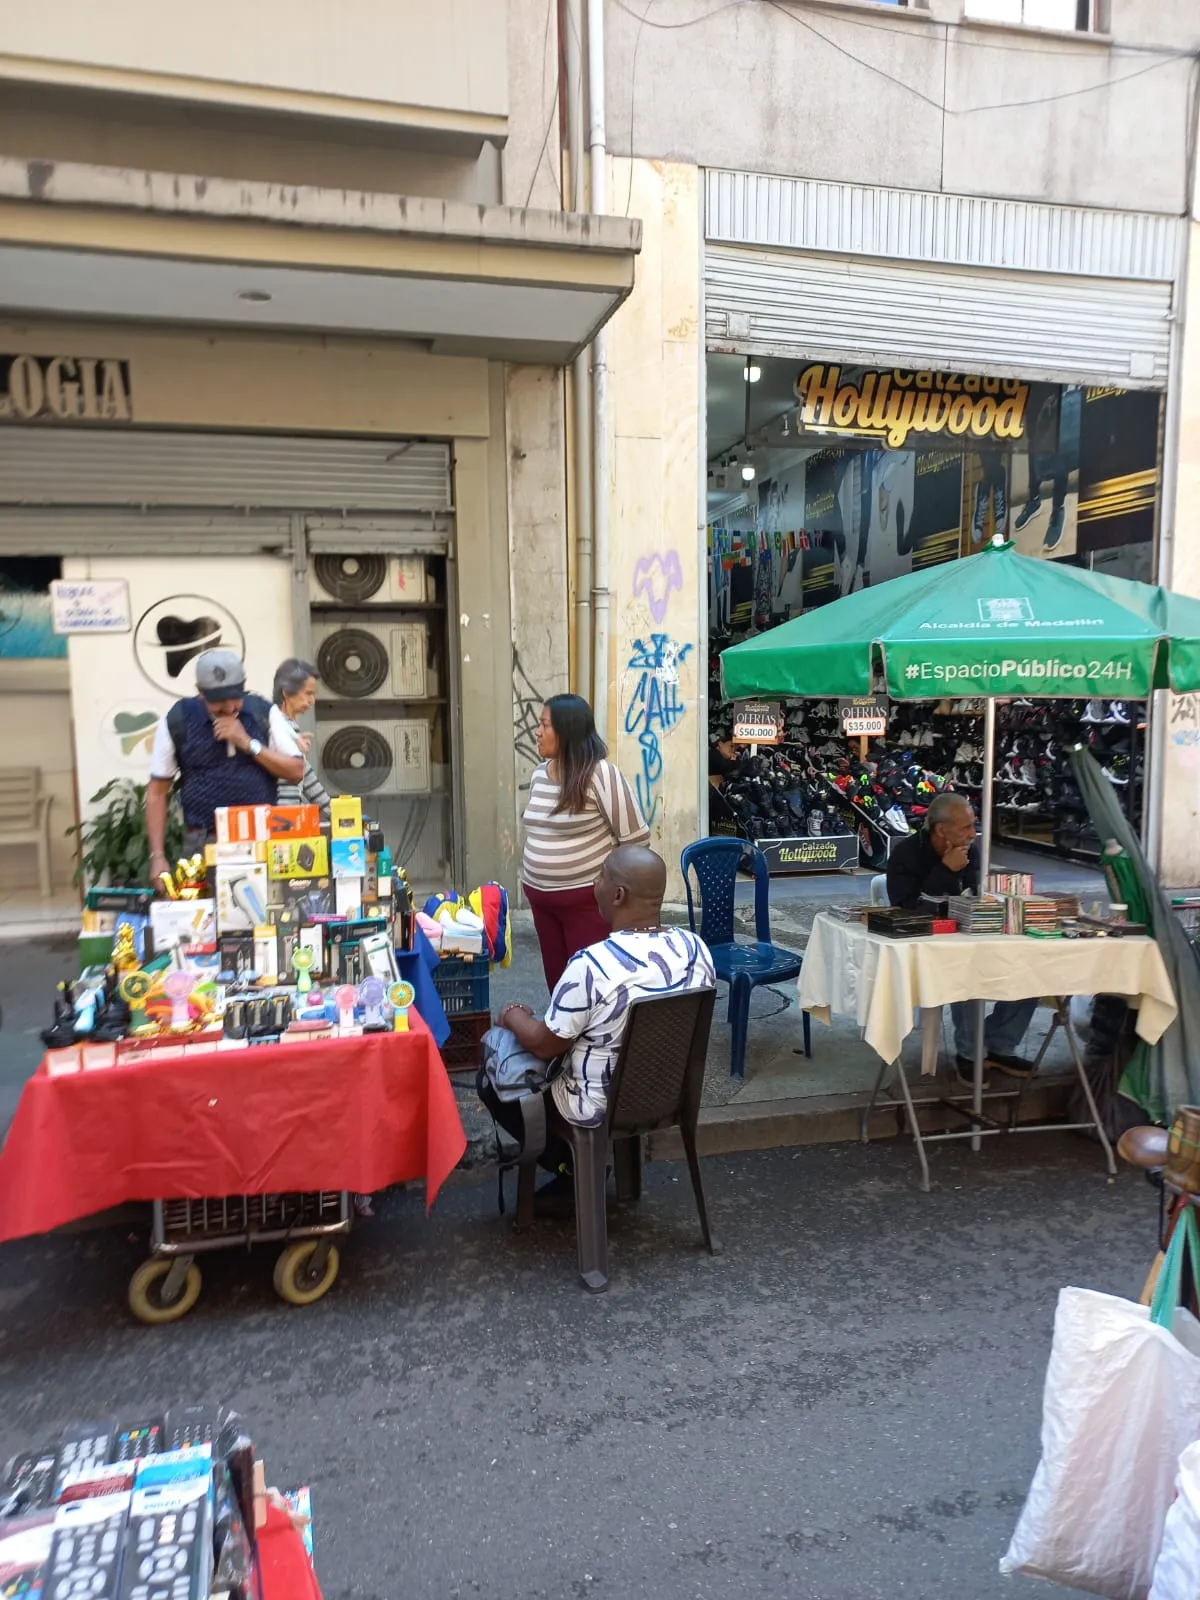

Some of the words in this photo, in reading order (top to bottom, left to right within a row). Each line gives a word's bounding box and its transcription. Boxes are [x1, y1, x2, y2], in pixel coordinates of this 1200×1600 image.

[797, 364, 1029, 448] Hollywood
[904, 658, 1133, 682] #EspacioPúblico24H
[739, 727, 773, 737] $50.000
[848, 721, 882, 731] $35.000
[802, 842, 835, 851] Calzado
[779, 847, 838, 863] Hollywood
